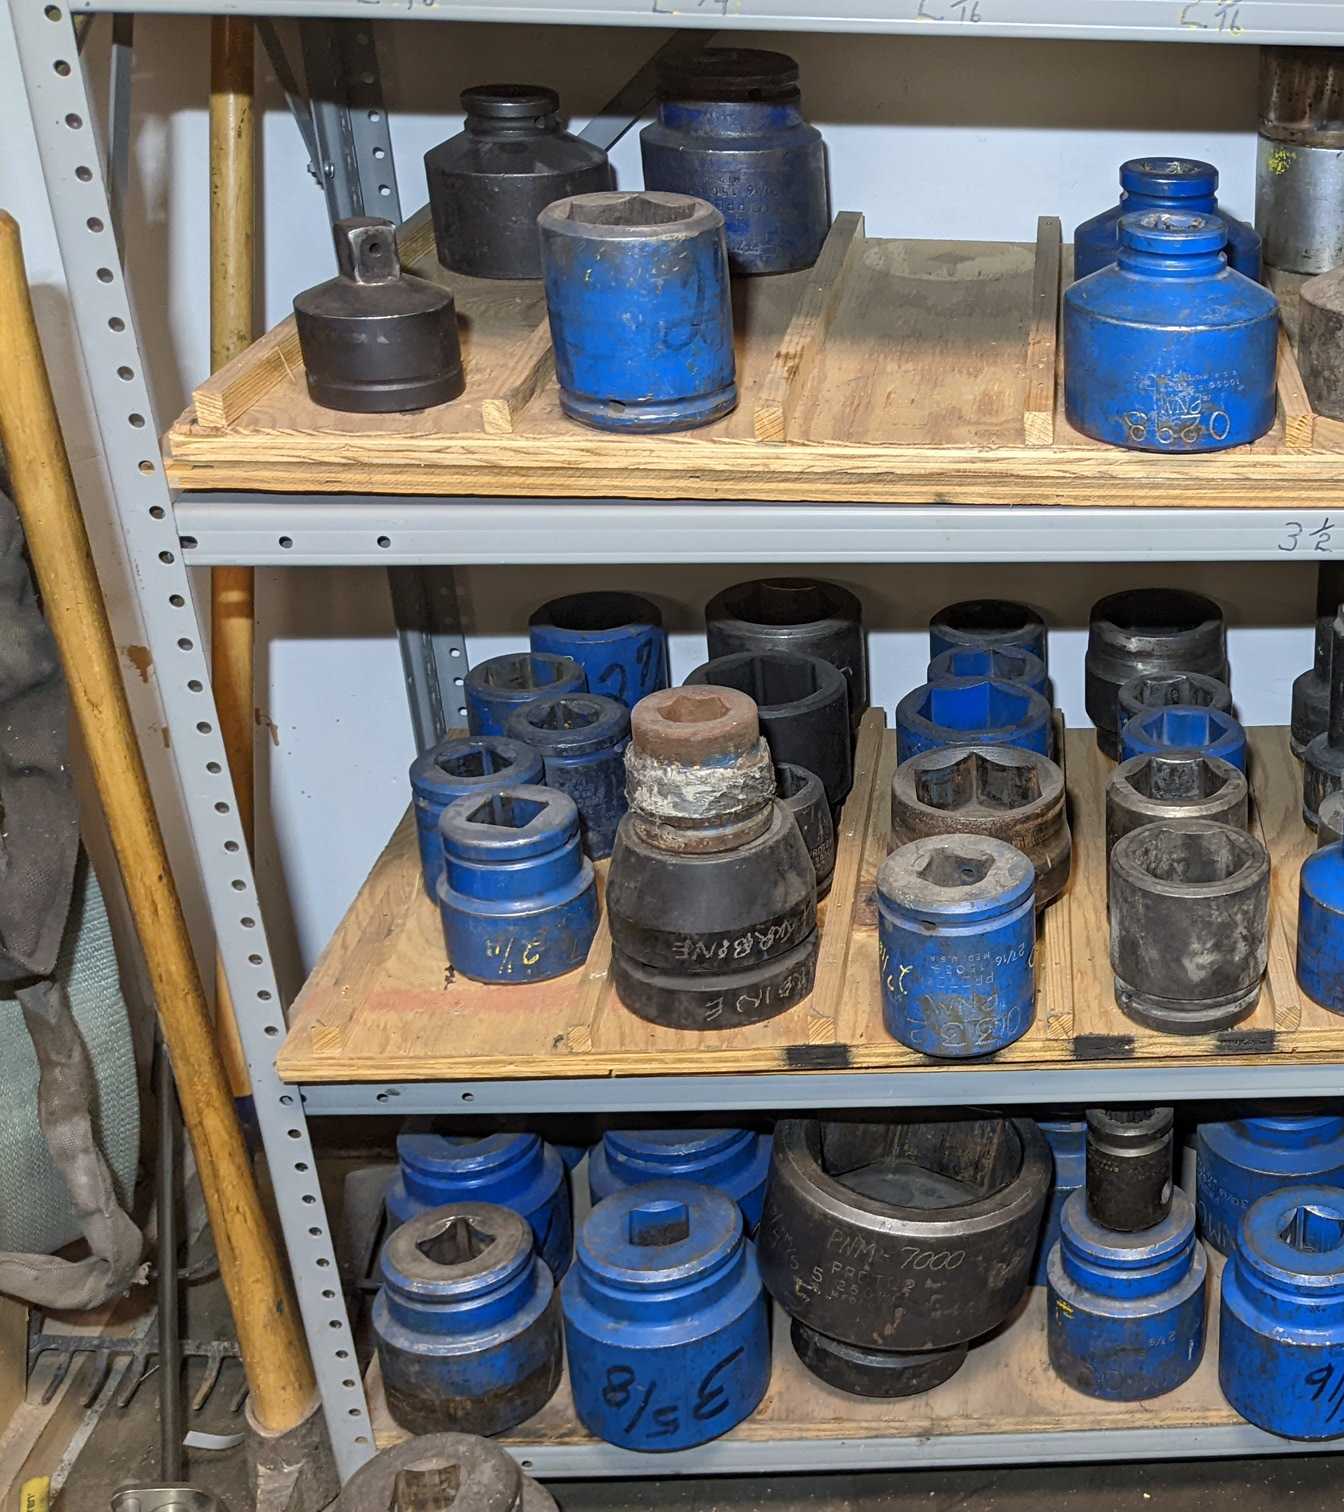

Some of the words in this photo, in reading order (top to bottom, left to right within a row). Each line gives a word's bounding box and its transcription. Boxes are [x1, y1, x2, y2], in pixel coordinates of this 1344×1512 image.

[1278, 521, 1302, 552] 3
[1308, 517, 1334, 553] 1/2
[899, 1246, 967, 1271] 7000
[601, 1365, 681, 1441] 5/8
[692, 1347, 745, 1422] 3
